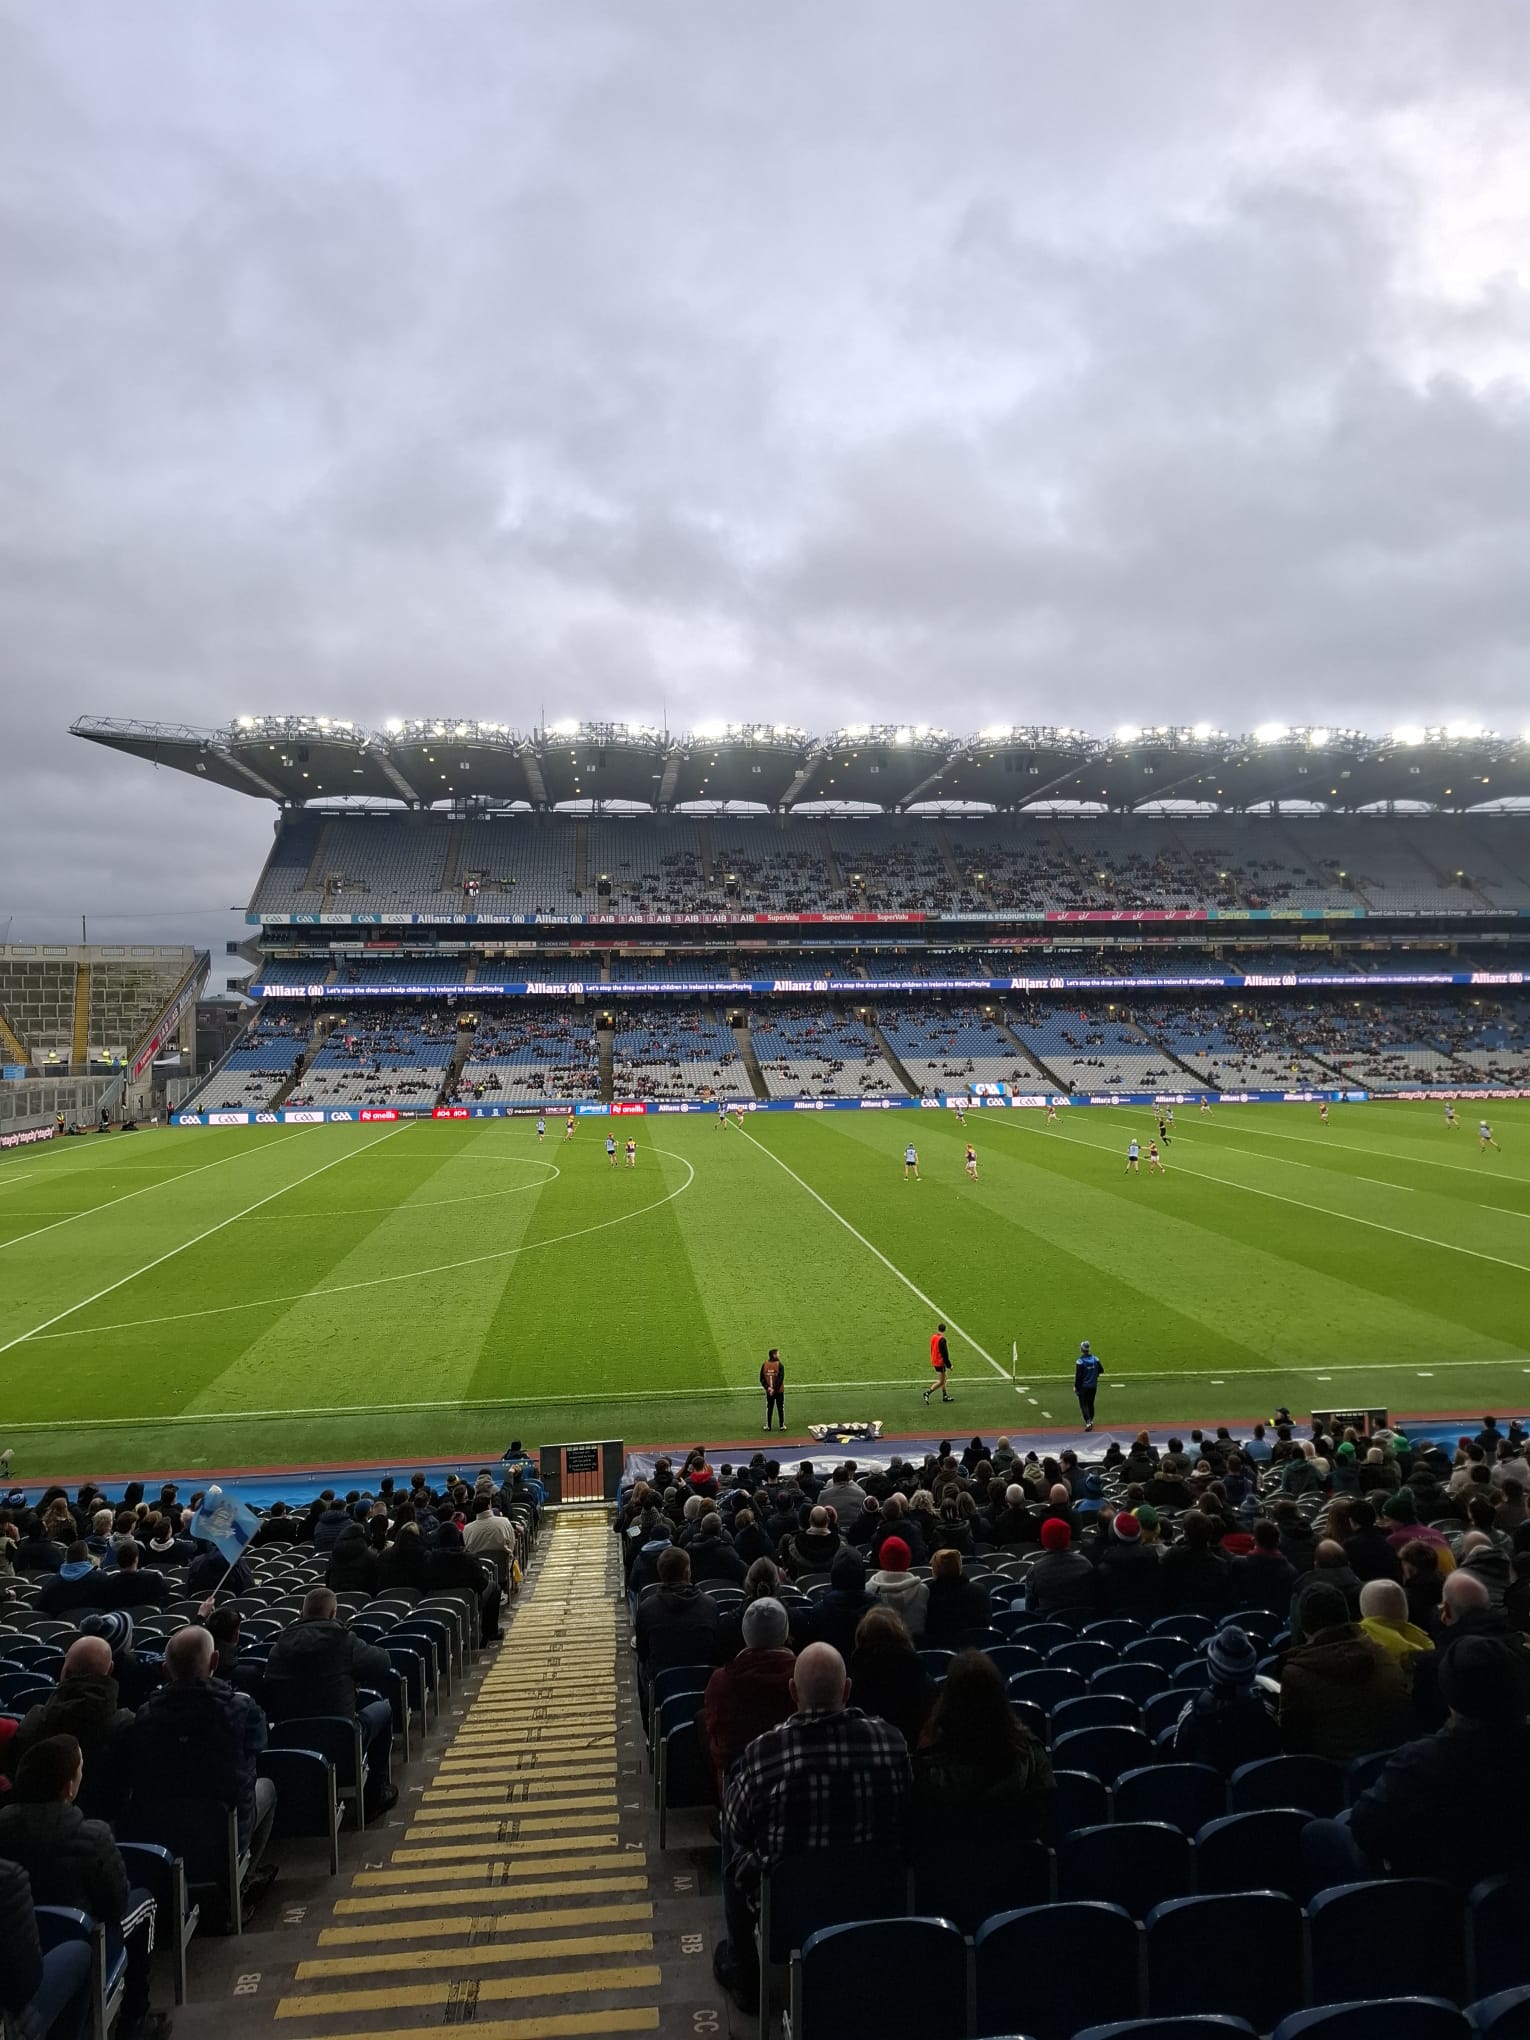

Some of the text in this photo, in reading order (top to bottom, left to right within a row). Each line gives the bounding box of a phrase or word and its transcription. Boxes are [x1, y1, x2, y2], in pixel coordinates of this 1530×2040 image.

[417, 914, 452, 923] Allianz
[476, 914, 510, 923] Allianz
[536, 914, 568, 923] Allianz
[1244, 976, 1280, 986] Allianz
[1471, 973, 1507, 983] Allianz
[773, 981, 811, 991] Allianz
[1011, 979, 1048, 988] Allianz
[263, 986, 306, 996] Allianz
[526, 983, 566, 994] Allianz
[1398, 1092, 1426, 1100] staycity
[1462, 1090, 1489, 1099] staycity
[1492, 1090, 1520, 1098] staycity
[921, 1099, 940, 1107] GAA
[1052, 1097, 1071, 1105] GAA
[180, 1115, 201, 1124] GAA
[256, 1114, 277, 1122] GAA
[294, 1112, 315, 1121] GAA
[331, 1112, 352, 1120] GAA
[673, 1876, 693, 1891] AA
[283, 1907, 307, 1923] AA
[681, 1933, 703, 1954] BB
[234, 1972, 261, 1995] BB
[693, 2010, 719, 2032] CC
